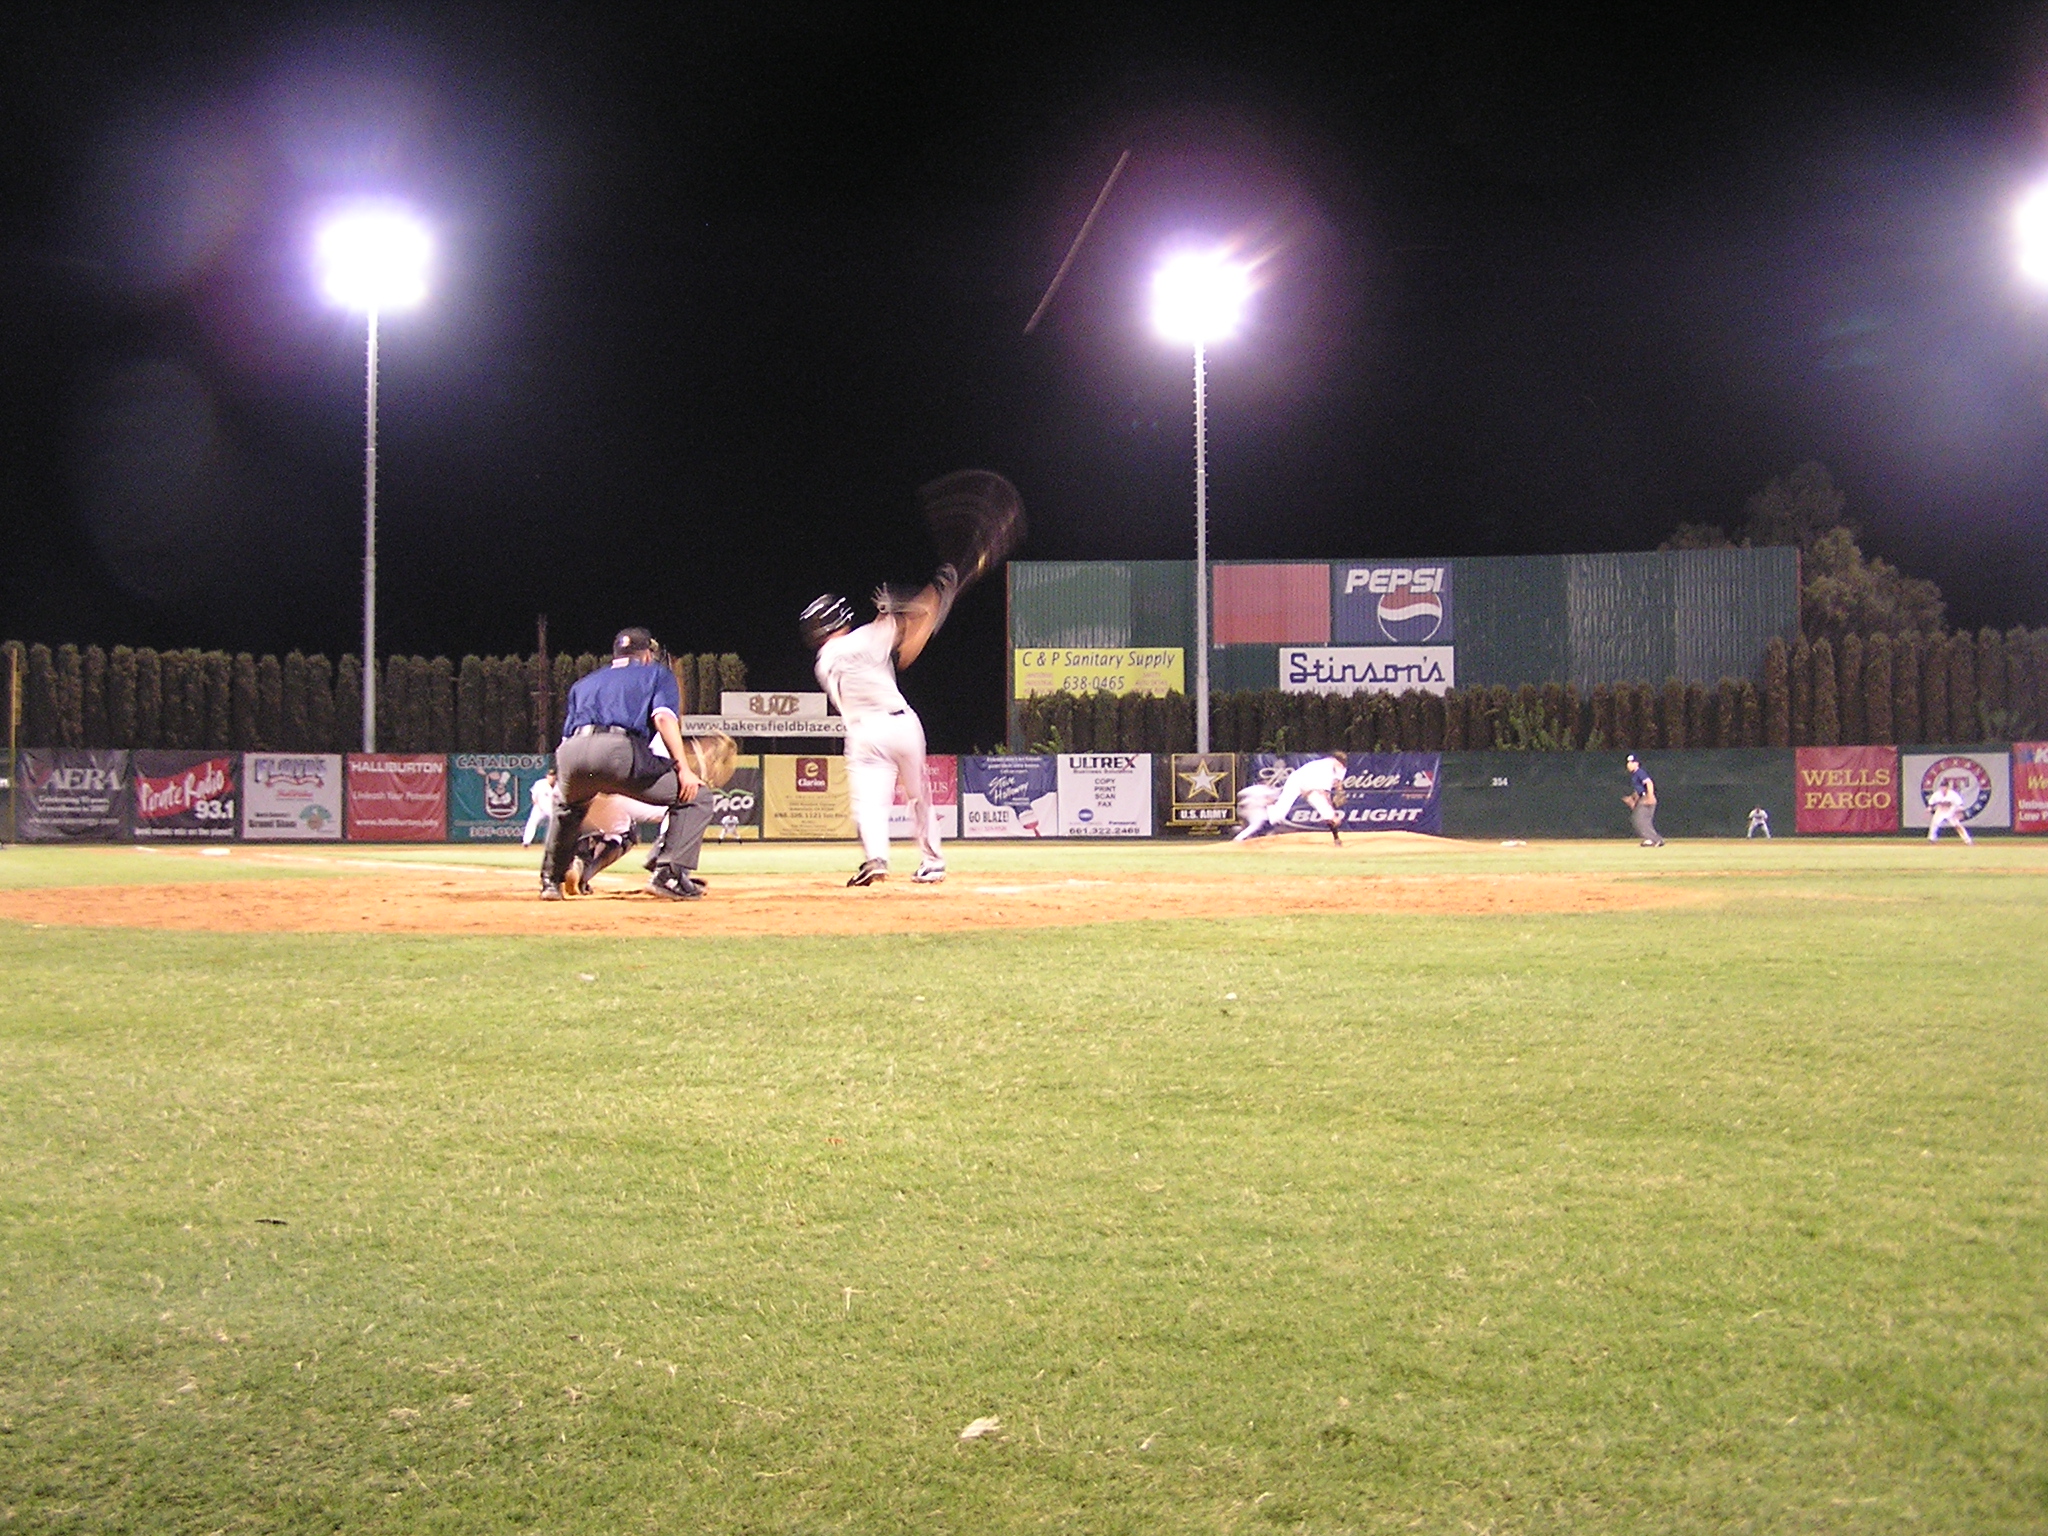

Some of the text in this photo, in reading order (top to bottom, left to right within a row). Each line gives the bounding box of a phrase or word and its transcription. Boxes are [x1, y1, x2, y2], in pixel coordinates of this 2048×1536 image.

[1345, 568, 1444, 593] PEPSI
[1023, 651, 1175, 669] C & P Sanitary Supply
[1289, 652, 1446, 684] Stinson's
[1063, 675, 1125, 691] 638-0465
[750, 694, 801, 716] BLAZE
[351, 762, 443, 773] HALLIBURTON
[457, 755, 544, 769] CATALDO'S
[1069, 757, 1136, 769] ULTREX
[41, 768, 124, 790] AERA
[797, 778, 826, 787] Clarion
[1802, 768, 1891, 786] WELLS
[1804, 792, 1892, 809] FARGO
[194, 799, 235, 819] 93.1
[969, 811, 981, 823] GO
[1180, 809, 1228, 819] U.S. ARMY
[1348, 809, 1423, 822] LIGHT
